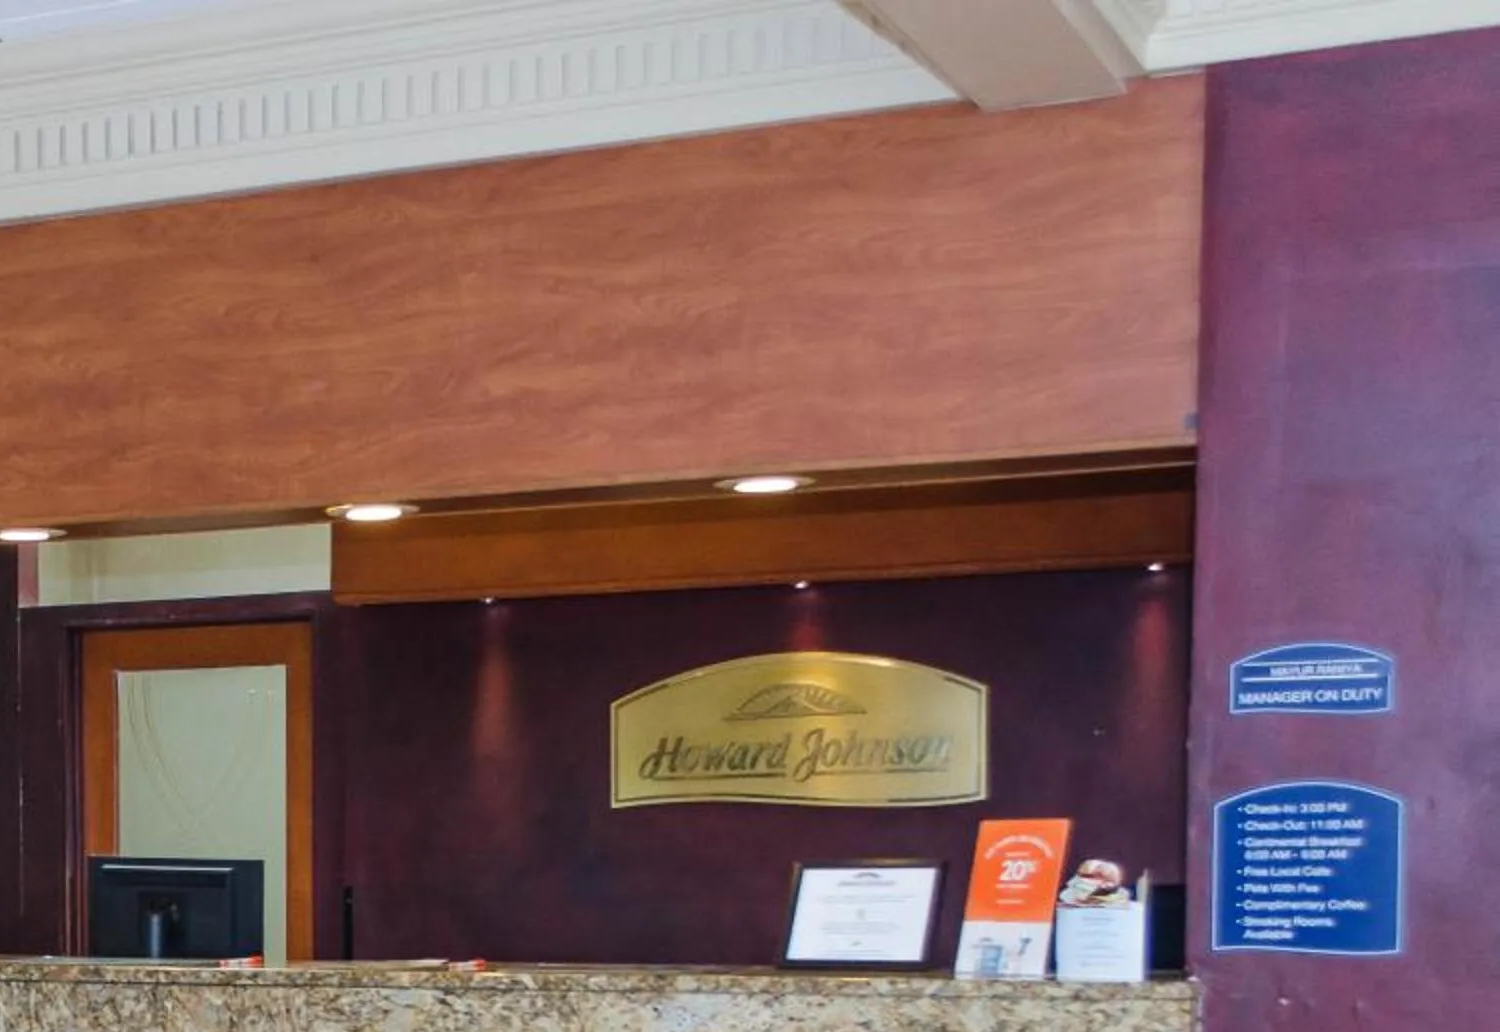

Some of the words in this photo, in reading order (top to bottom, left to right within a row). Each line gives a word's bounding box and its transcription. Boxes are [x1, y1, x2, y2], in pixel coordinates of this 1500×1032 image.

[1238, 690, 1312, 705] MANAGER
[1315, 689, 1338, 703] ON
[1342, 687, 1383, 702] DUTY
[639, 733, 791, 782] Howard
[792, 729, 953, 784] Johnson
[1343, 819, 1364, 829] AM
[1243, 867, 1268, 877] Free
[1270, 867, 1300, 877] Local
[1271, 883, 1296, 893] With
[1327, 900, 1367, 911] Coffee
[1293, 916, 1335, 927] Rooms
